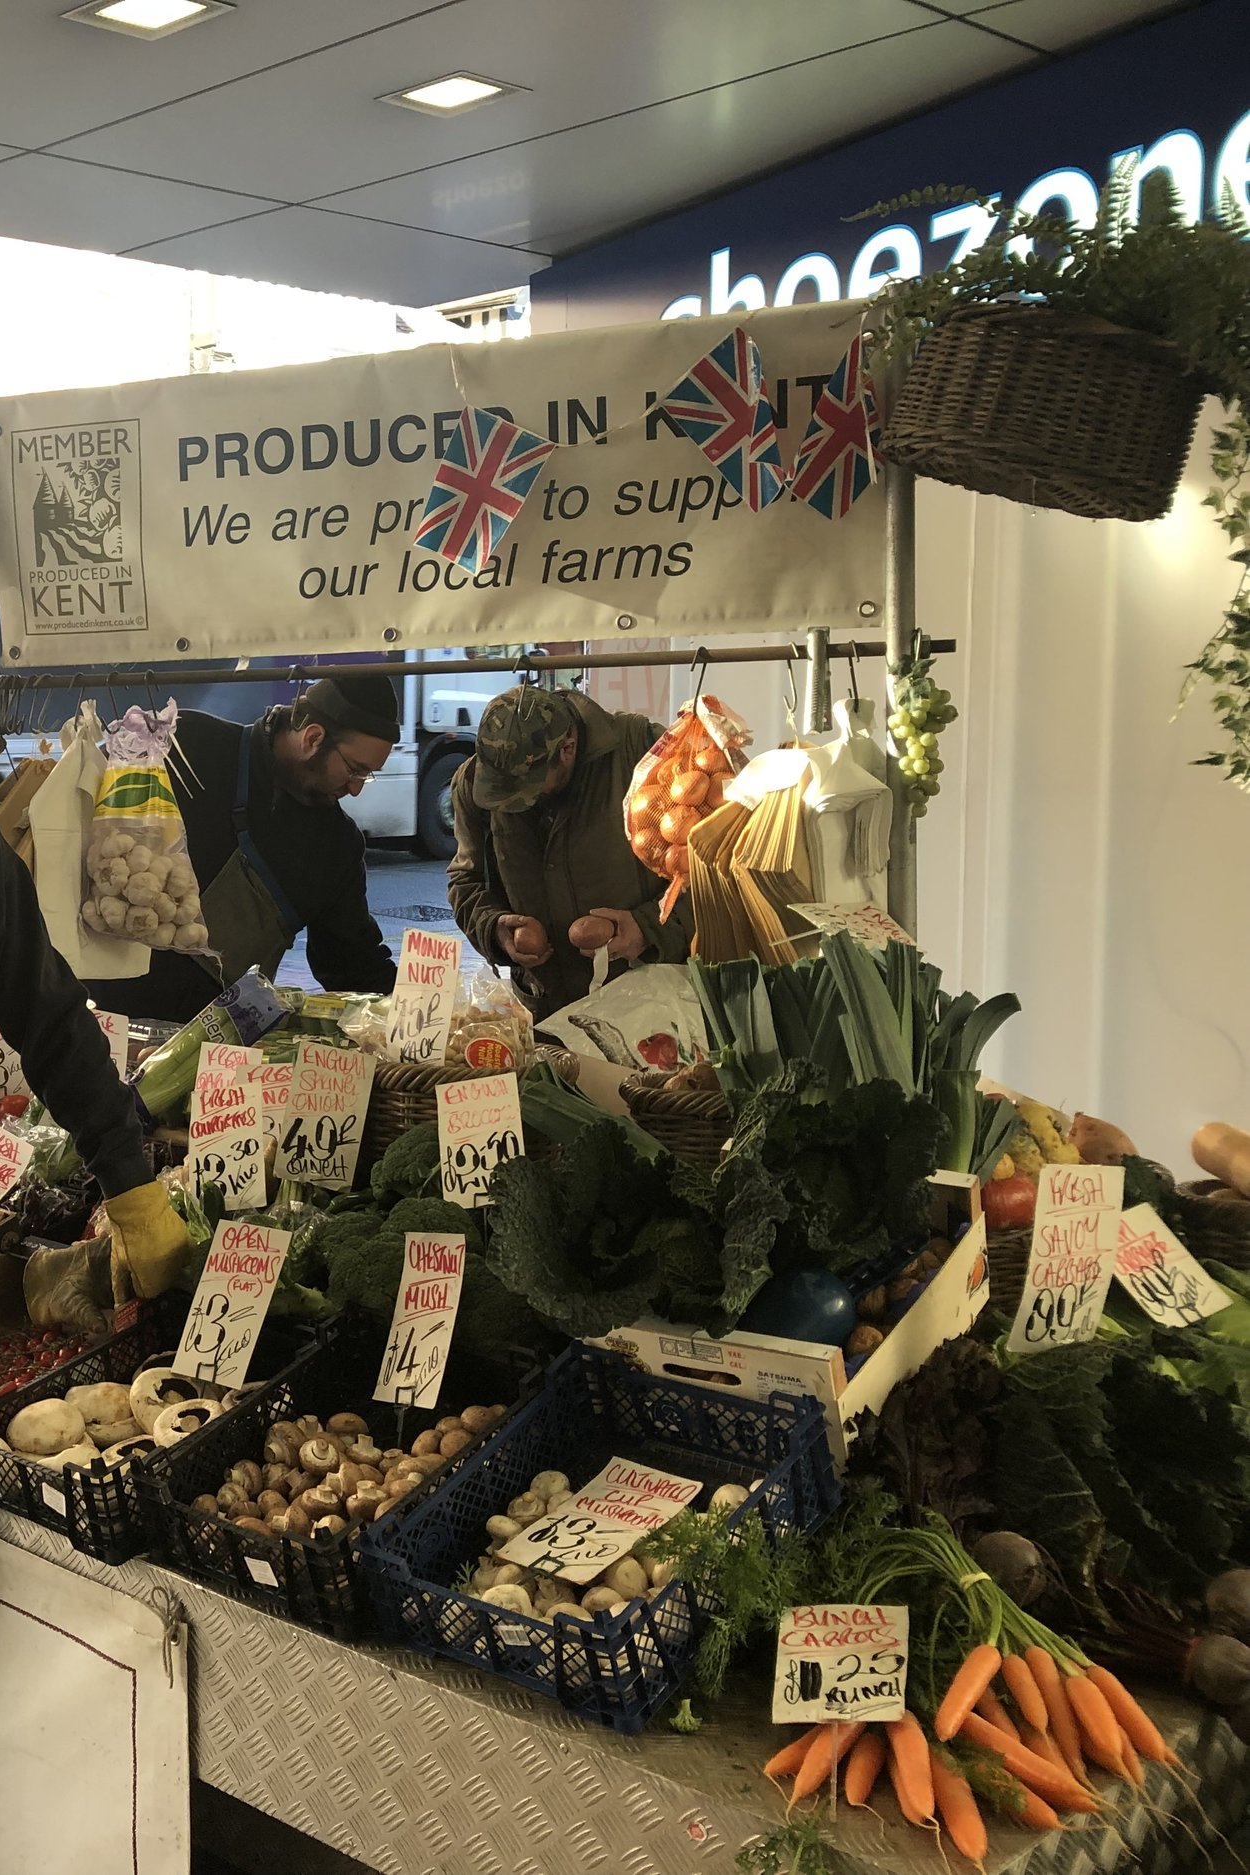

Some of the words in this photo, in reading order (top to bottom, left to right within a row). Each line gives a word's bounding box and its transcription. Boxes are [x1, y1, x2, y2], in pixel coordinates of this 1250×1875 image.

[548, 395, 608, 446] IN
[645, 374, 835, 442] KNT
[18, 428, 132, 463] MEMBER
[183, 503, 251, 547] We
[272, 503, 350, 541] are
[542, 478, 590, 521] to
[614, 472, 797, 524] supp
[29, 566, 111, 584] PRODUCED
[115, 564, 132, 579] IN
[299, 561, 379, 600] our
[398, 543, 520, 594] local
[541, 540, 694, 585] farms
[31, 580, 133, 618] KENT
[408, 931, 457, 970] MONKEY
[408, 962, 445, 987] NUTS
[247, 1065, 294, 1084] FRES
[199, 1086, 246, 1115] FRESH
[222, 1227, 279, 1252] OPEN
[1035, 1212, 1102, 1258] SAVOY
[206, 1252, 281, 1283] MUSHROOMS
[405, 1283, 452, 1311] MUSH
[604, 1489, 654, 1507] CUP
[793, 1606, 888, 1628] BUNCH
[781, 1627, 900, 1649] CARROTS
[825, 1677, 902, 1706] BUNCH
